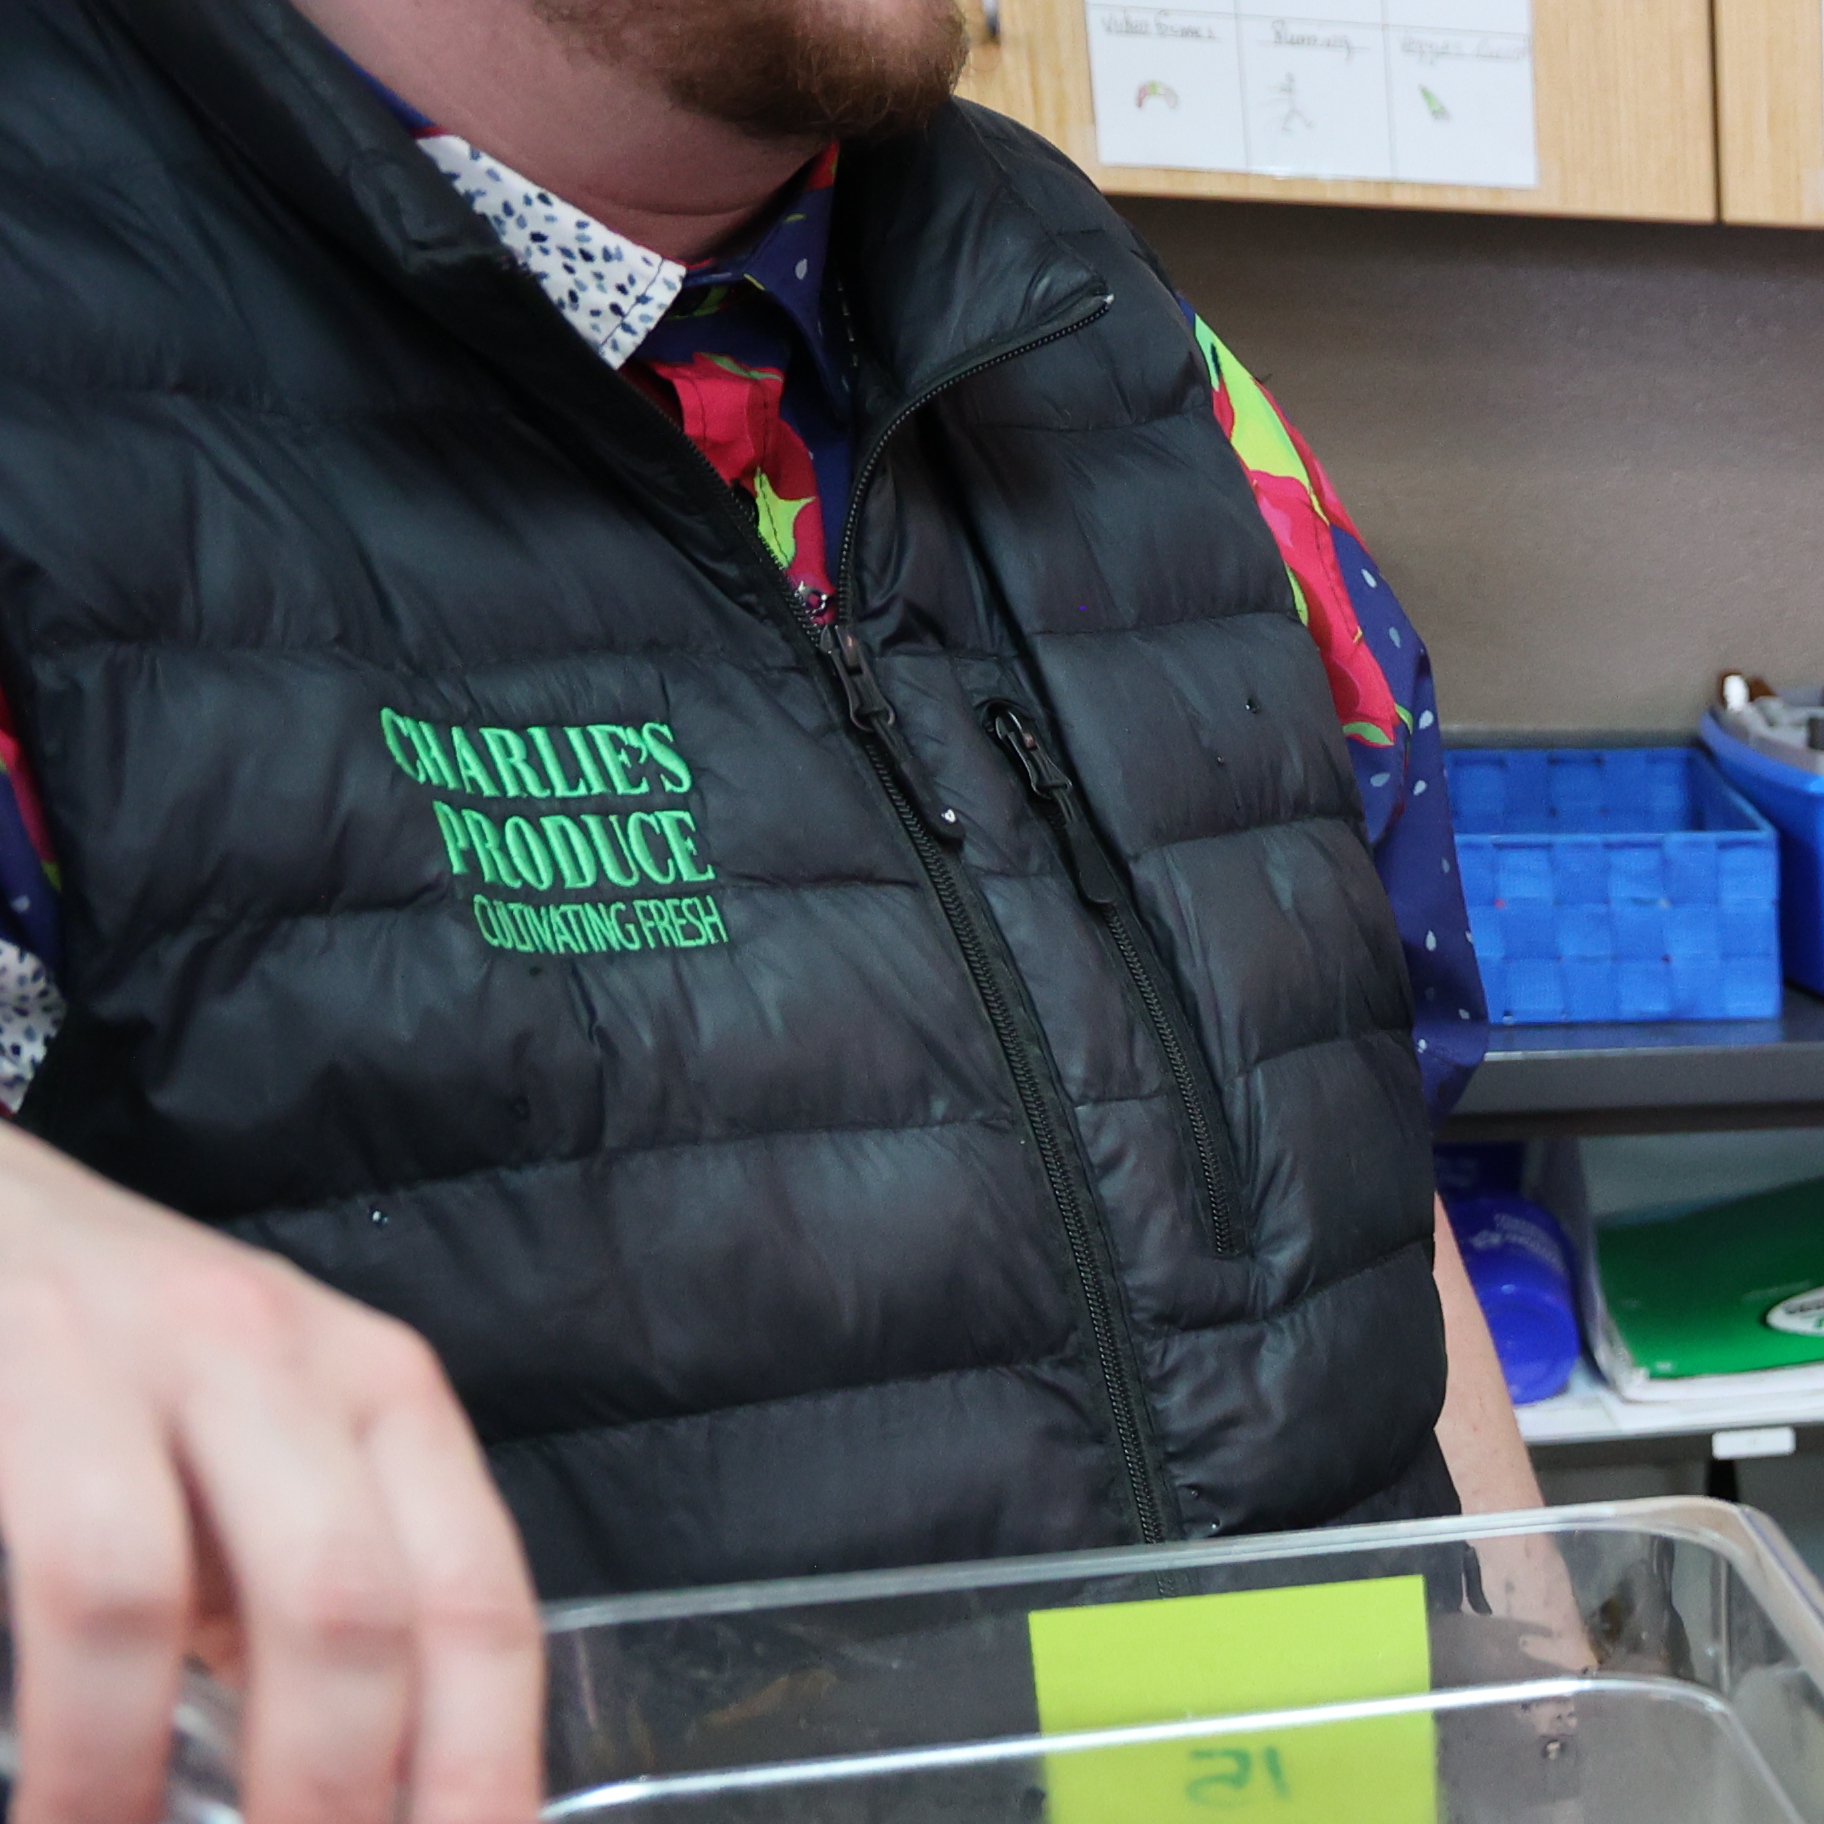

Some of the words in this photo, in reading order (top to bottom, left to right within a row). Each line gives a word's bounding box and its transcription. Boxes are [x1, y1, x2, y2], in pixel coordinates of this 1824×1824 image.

[380, 707, 692, 798] CHARLIE'S
[432, 801, 716, 890] PRODUCE
[473, 894, 639, 954] CULTIVATING
[637, 895, 729, 949] FRESH
